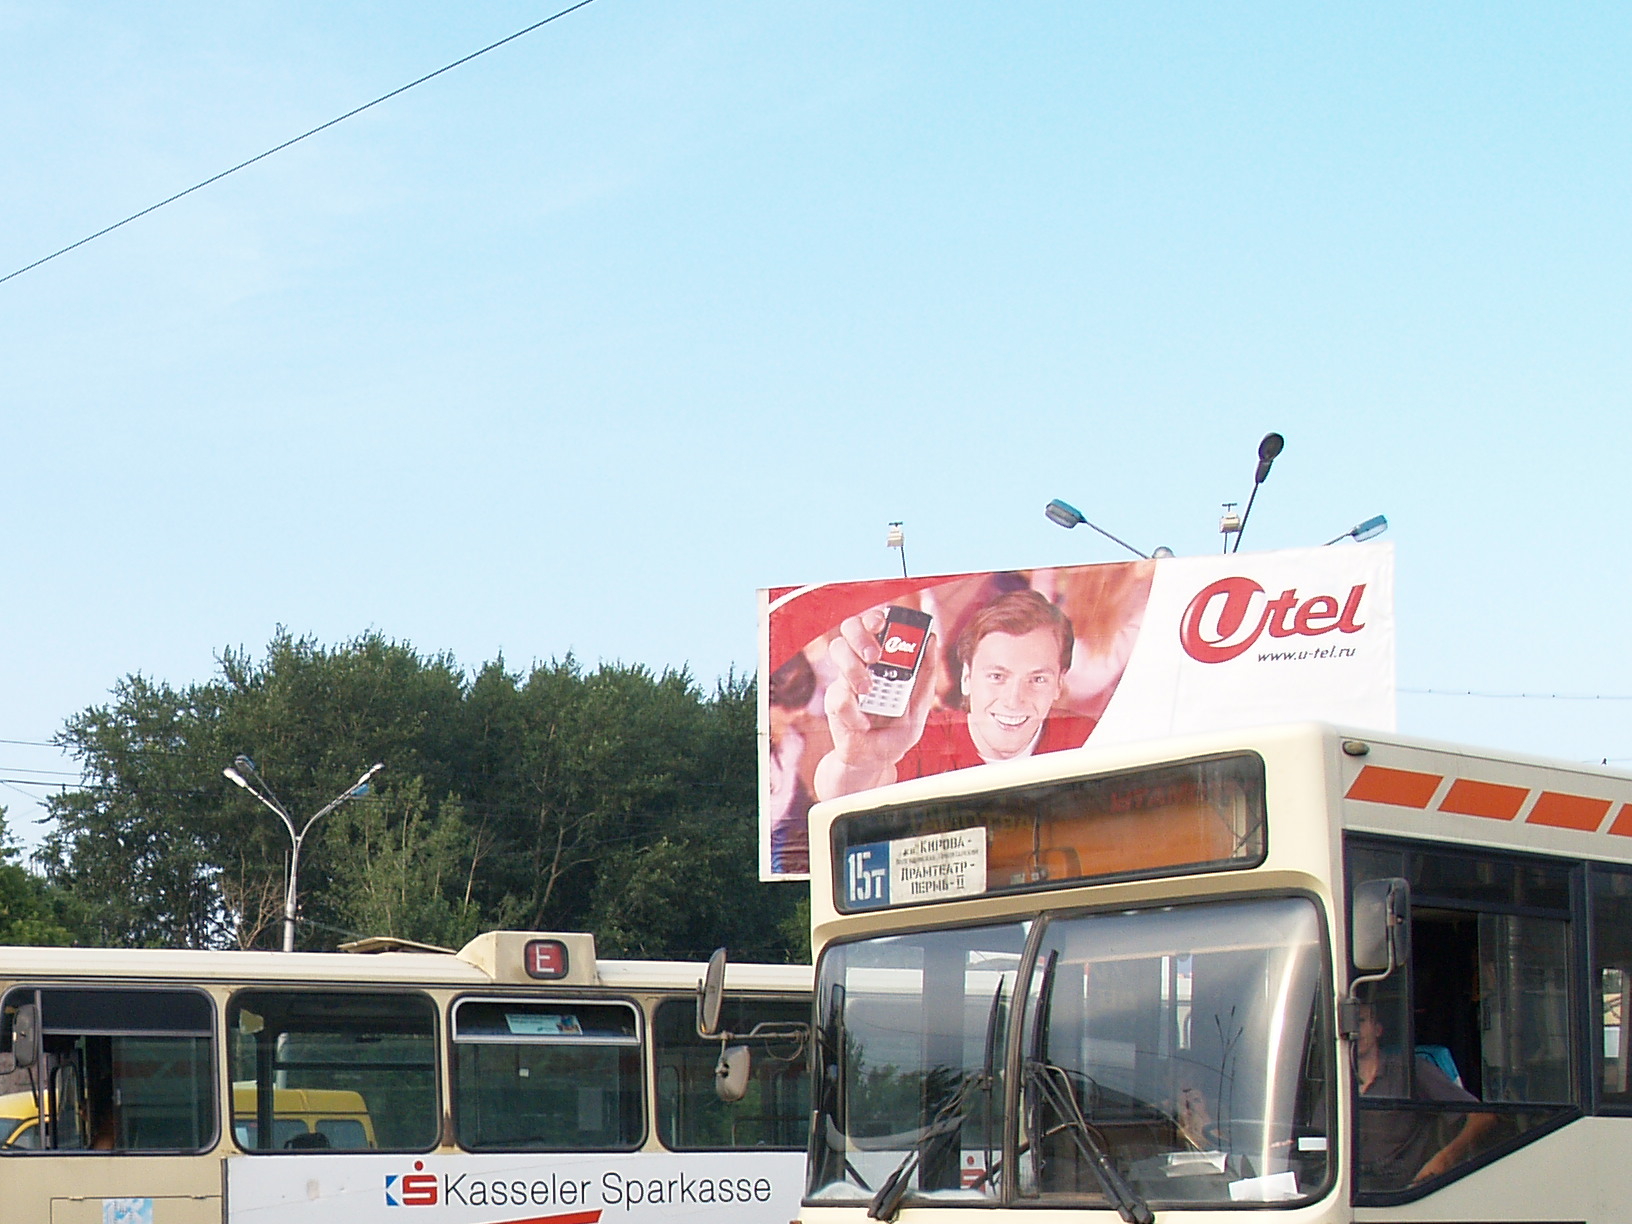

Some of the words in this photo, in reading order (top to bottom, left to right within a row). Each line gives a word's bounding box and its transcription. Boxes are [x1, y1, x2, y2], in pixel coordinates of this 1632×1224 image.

[1180, 576, 1367, 664] Utel
[1257, 645, 1356, 662] www.u-tel.ru
[901, 861, 968, 882] ДРАМТЕАТР
[535, 943, 555, 973] E
[444, 1173, 592, 1206] Kasseler
[601, 1171, 771, 1211] Sparkasse
